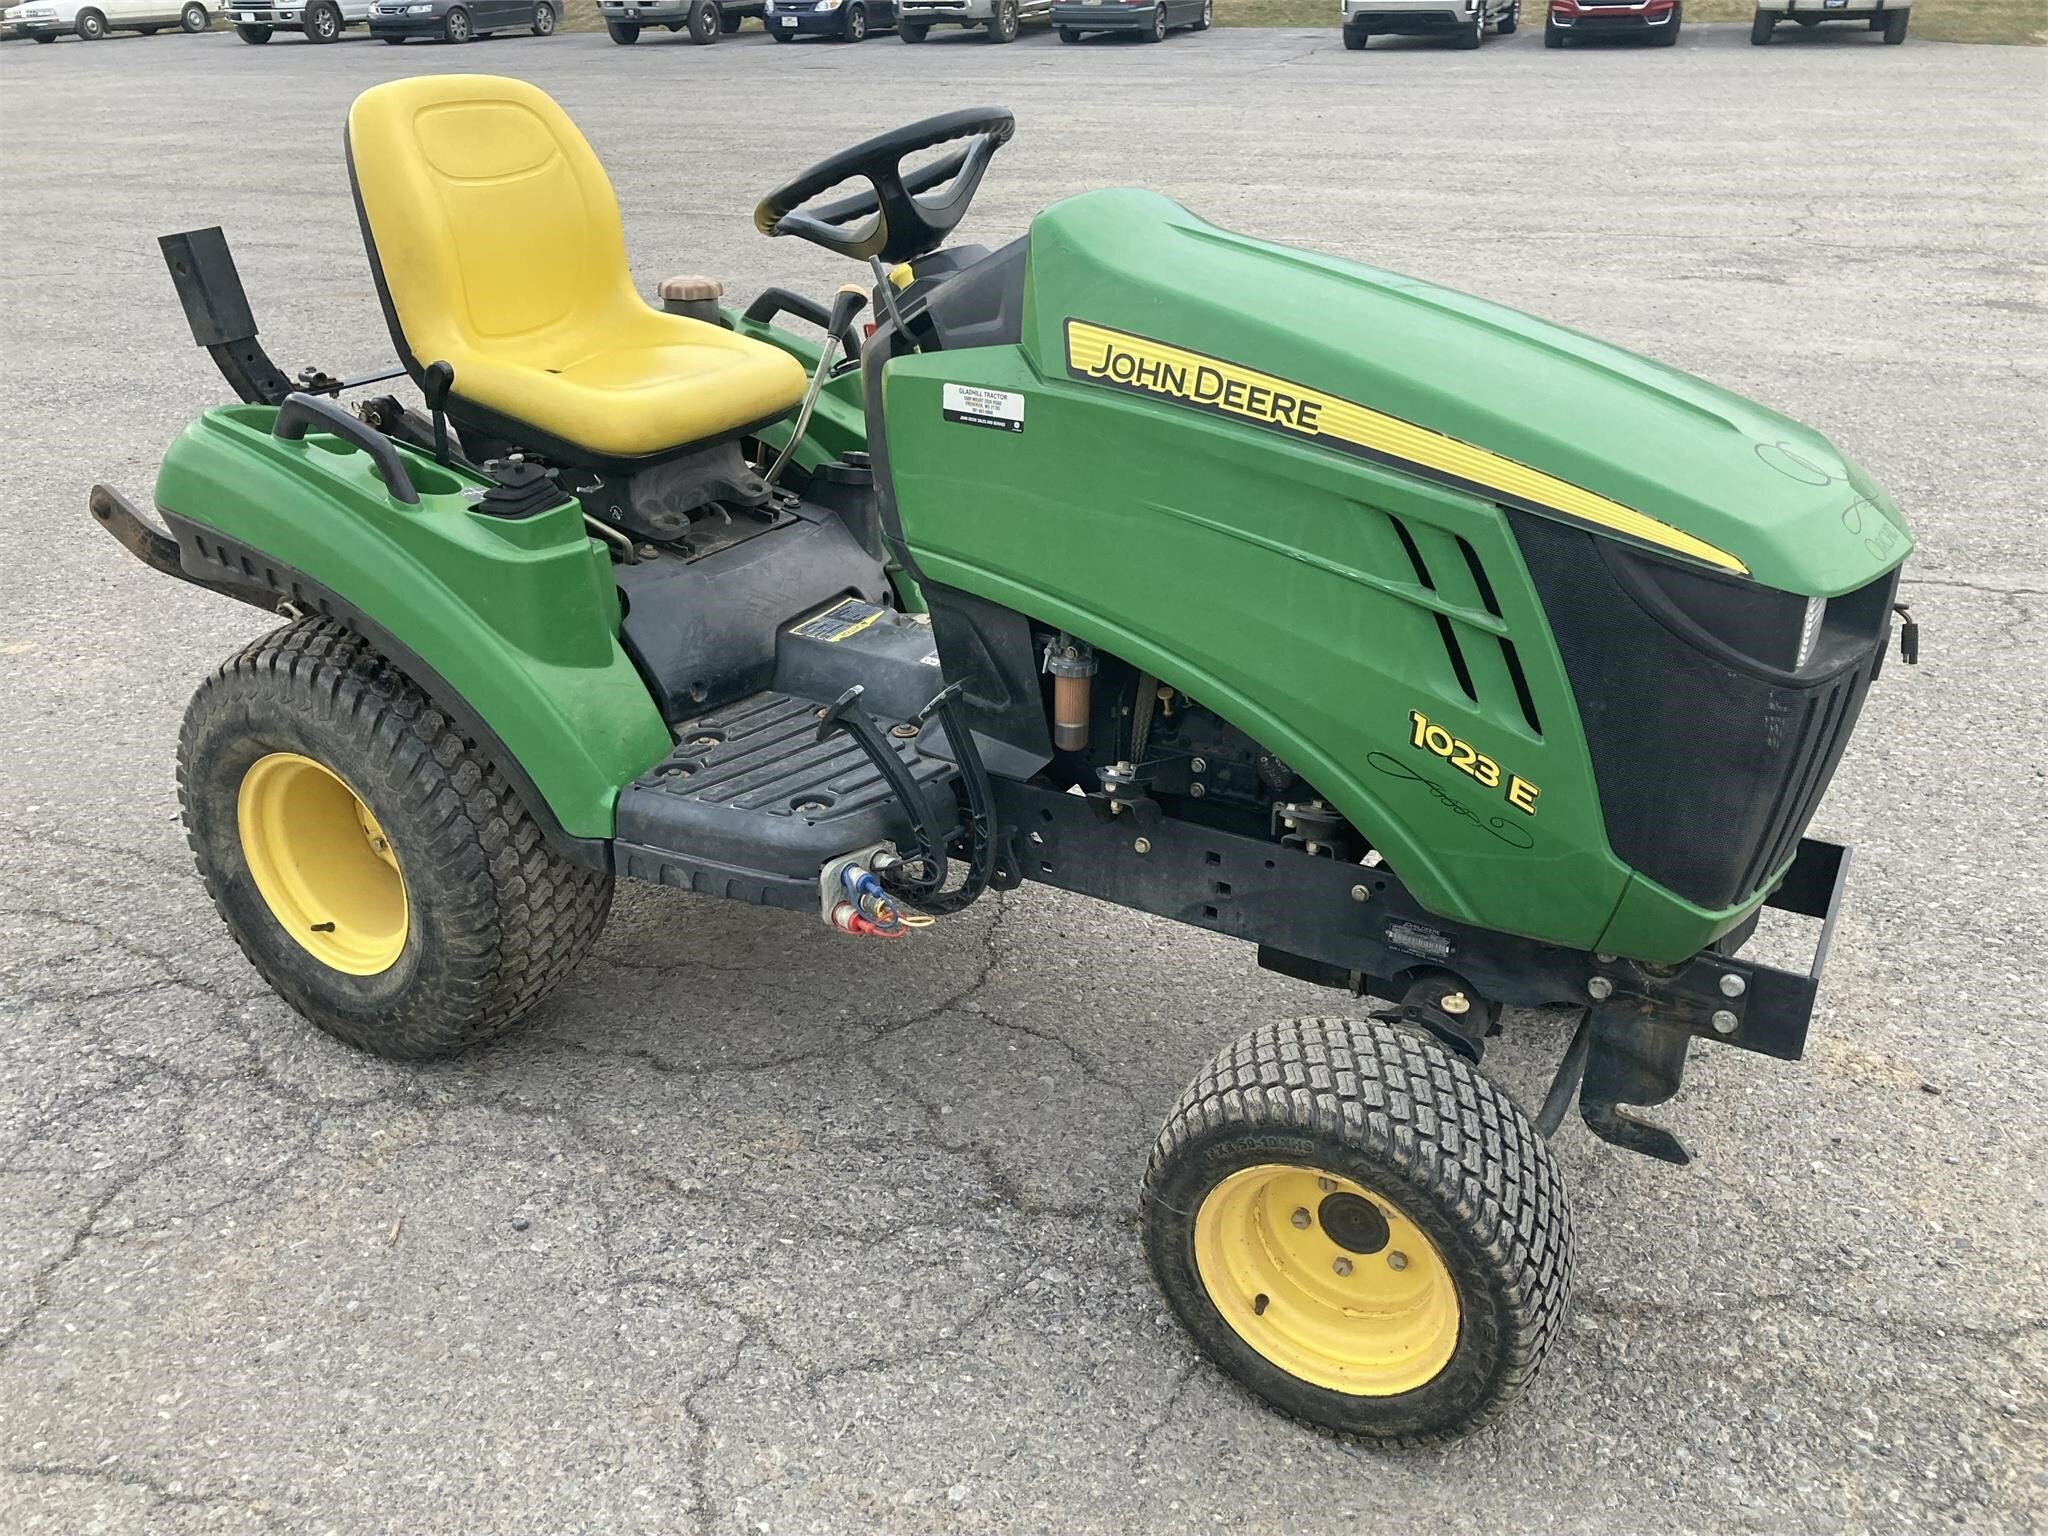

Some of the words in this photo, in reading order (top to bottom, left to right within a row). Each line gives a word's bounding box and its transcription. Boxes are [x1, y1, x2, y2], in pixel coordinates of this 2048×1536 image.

[959, 388, 983, 398] GLADHILL
[984, 391, 1008, 401] TRACTOR
[1091, 343, 1187, 393] JOHN
[1195, 365, 1322, 431] DEERE
[1409, 709, 1501, 789] 1023
[1505, 774, 1541, 816] E
